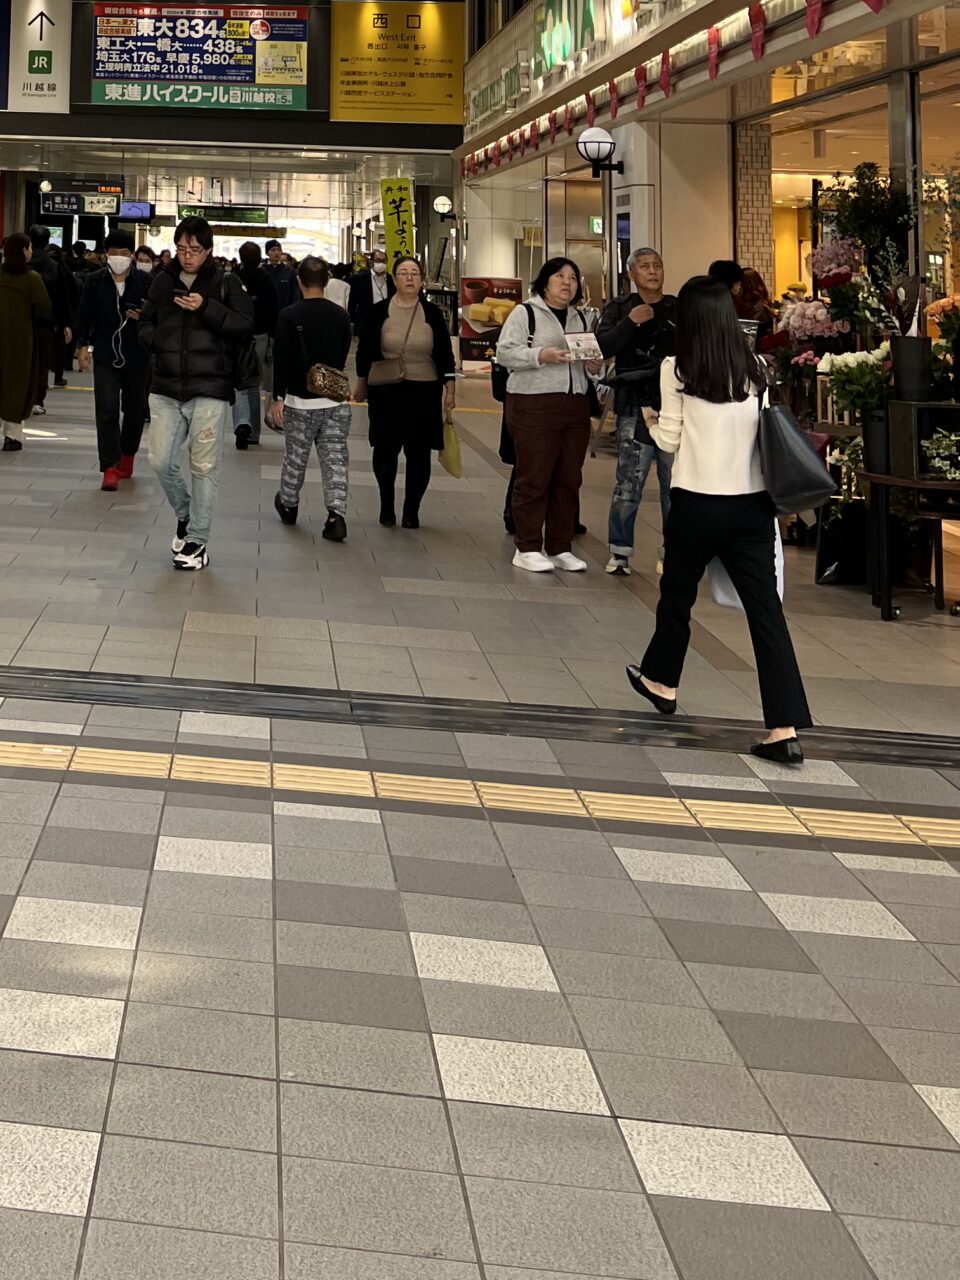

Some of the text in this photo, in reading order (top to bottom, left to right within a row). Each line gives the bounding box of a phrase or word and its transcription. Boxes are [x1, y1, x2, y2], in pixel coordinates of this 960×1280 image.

[372, 13, 421, 29] 西口
[378, 33, 398, 41] West
[32, 56, 48, 69] JR
[22, 82, 57, 92] 川越線
[105, 83, 229, 103] 東進ハイスクール
[191, 208, 205, 217] JR
